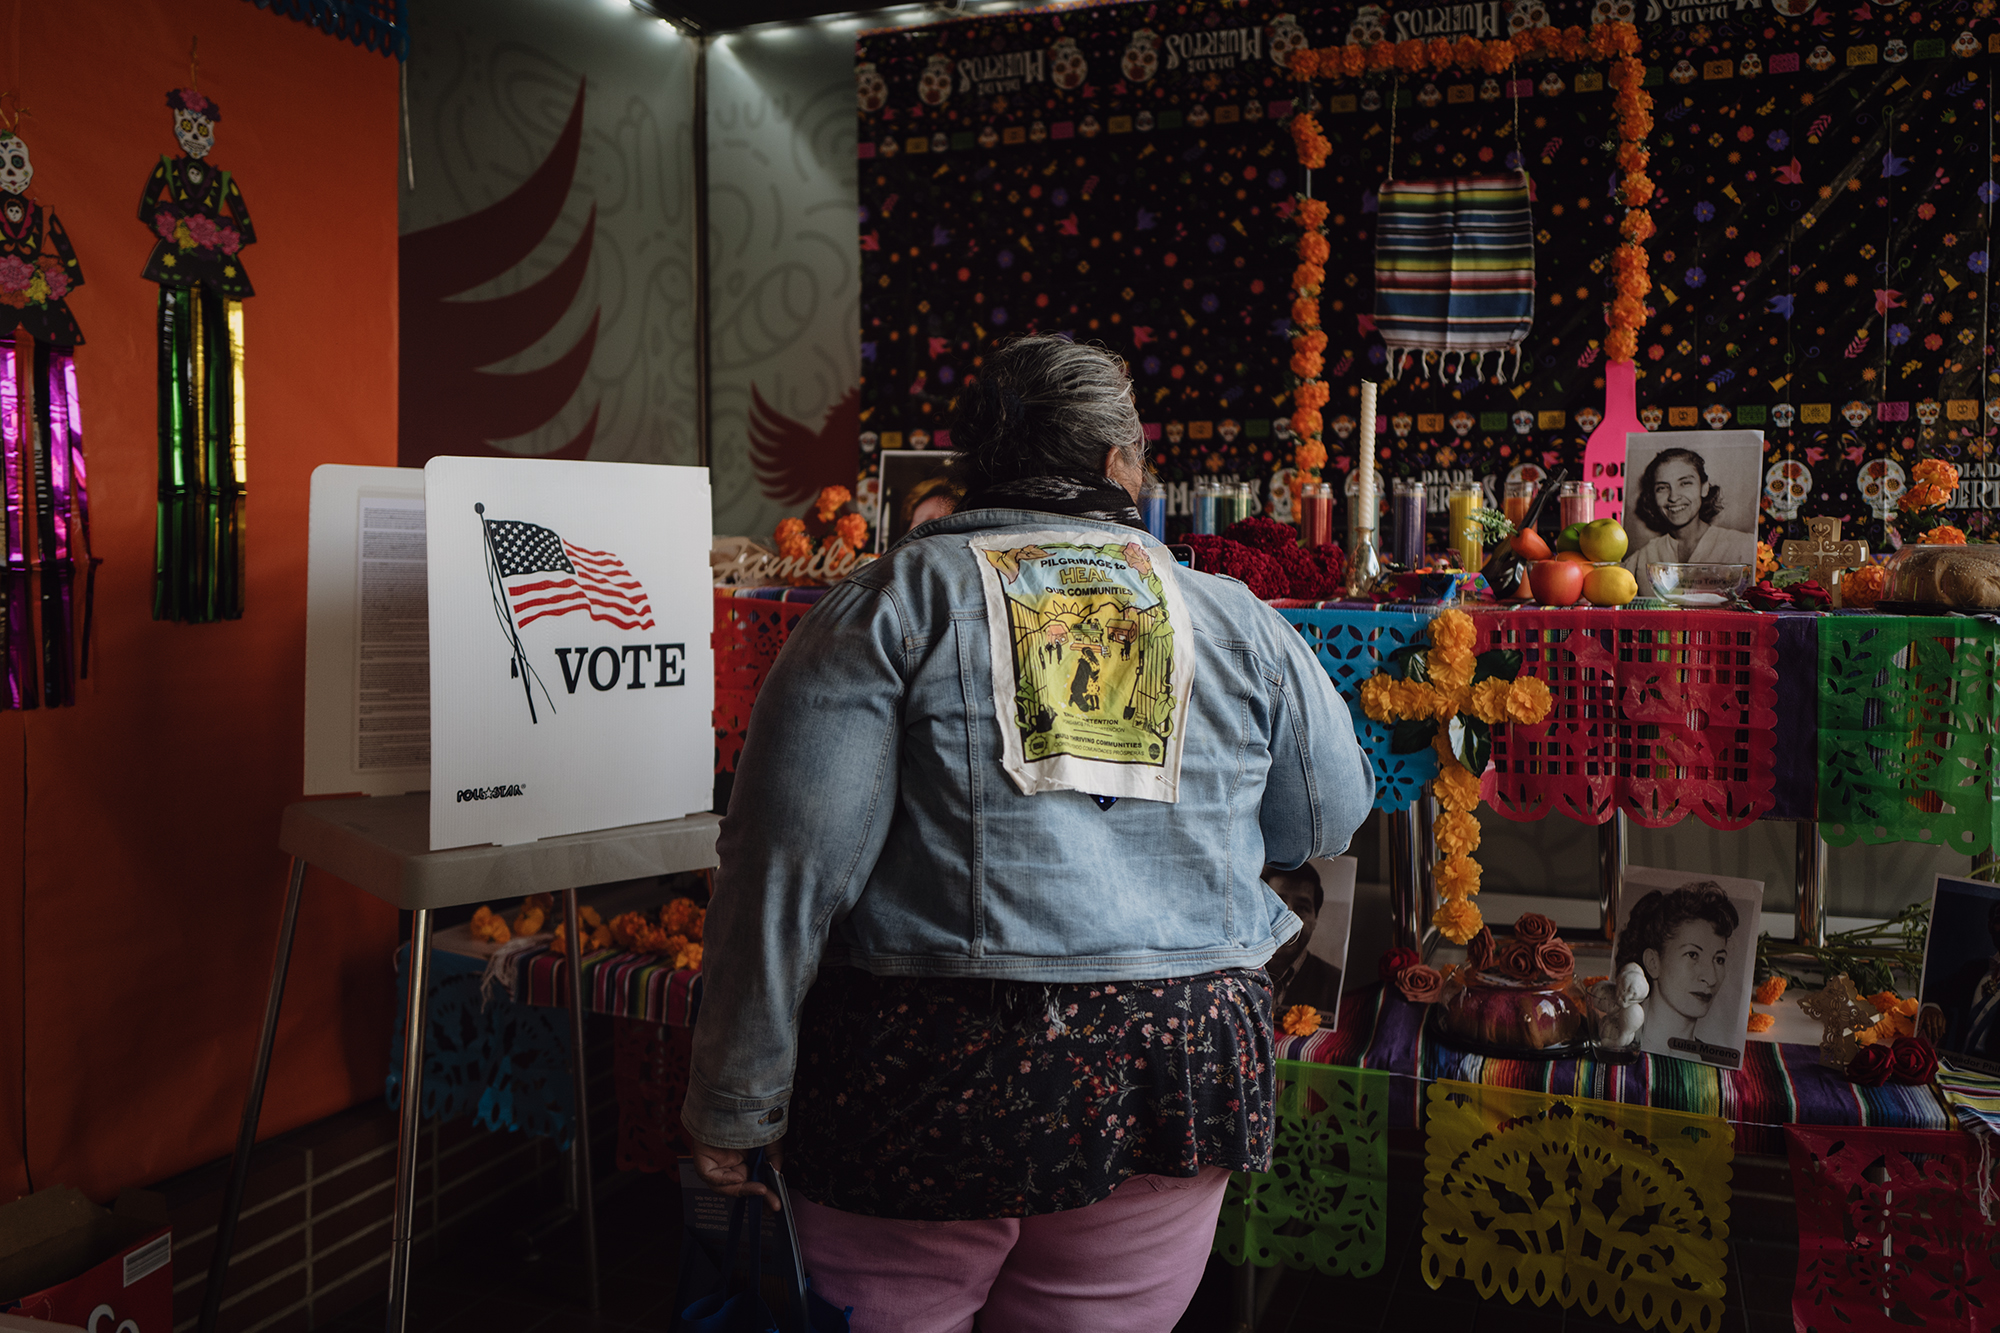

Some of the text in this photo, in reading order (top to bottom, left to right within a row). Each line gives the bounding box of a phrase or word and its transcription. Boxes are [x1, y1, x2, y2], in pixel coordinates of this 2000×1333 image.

[1695, 4, 1729, 22] DIA
[1165, 25, 1263, 70] MUERTOS
[957, 49, 1045, 93] MUERTOS
[1207, 55, 1235, 70] DIA
[1422, 469, 1451, 485] DIA
[1040, 558, 1126, 570] PILGRIMAGE to
[1060, 567, 1113, 585] HEAL
[1045, 586, 1133, 597] OUR COMMUNITIES
[555, 643, 685, 694] VOTE
[1096, 739, 1142, 748] COMMUNITIES
[1673, 1039, 1738, 1059] Luisa Moreno
